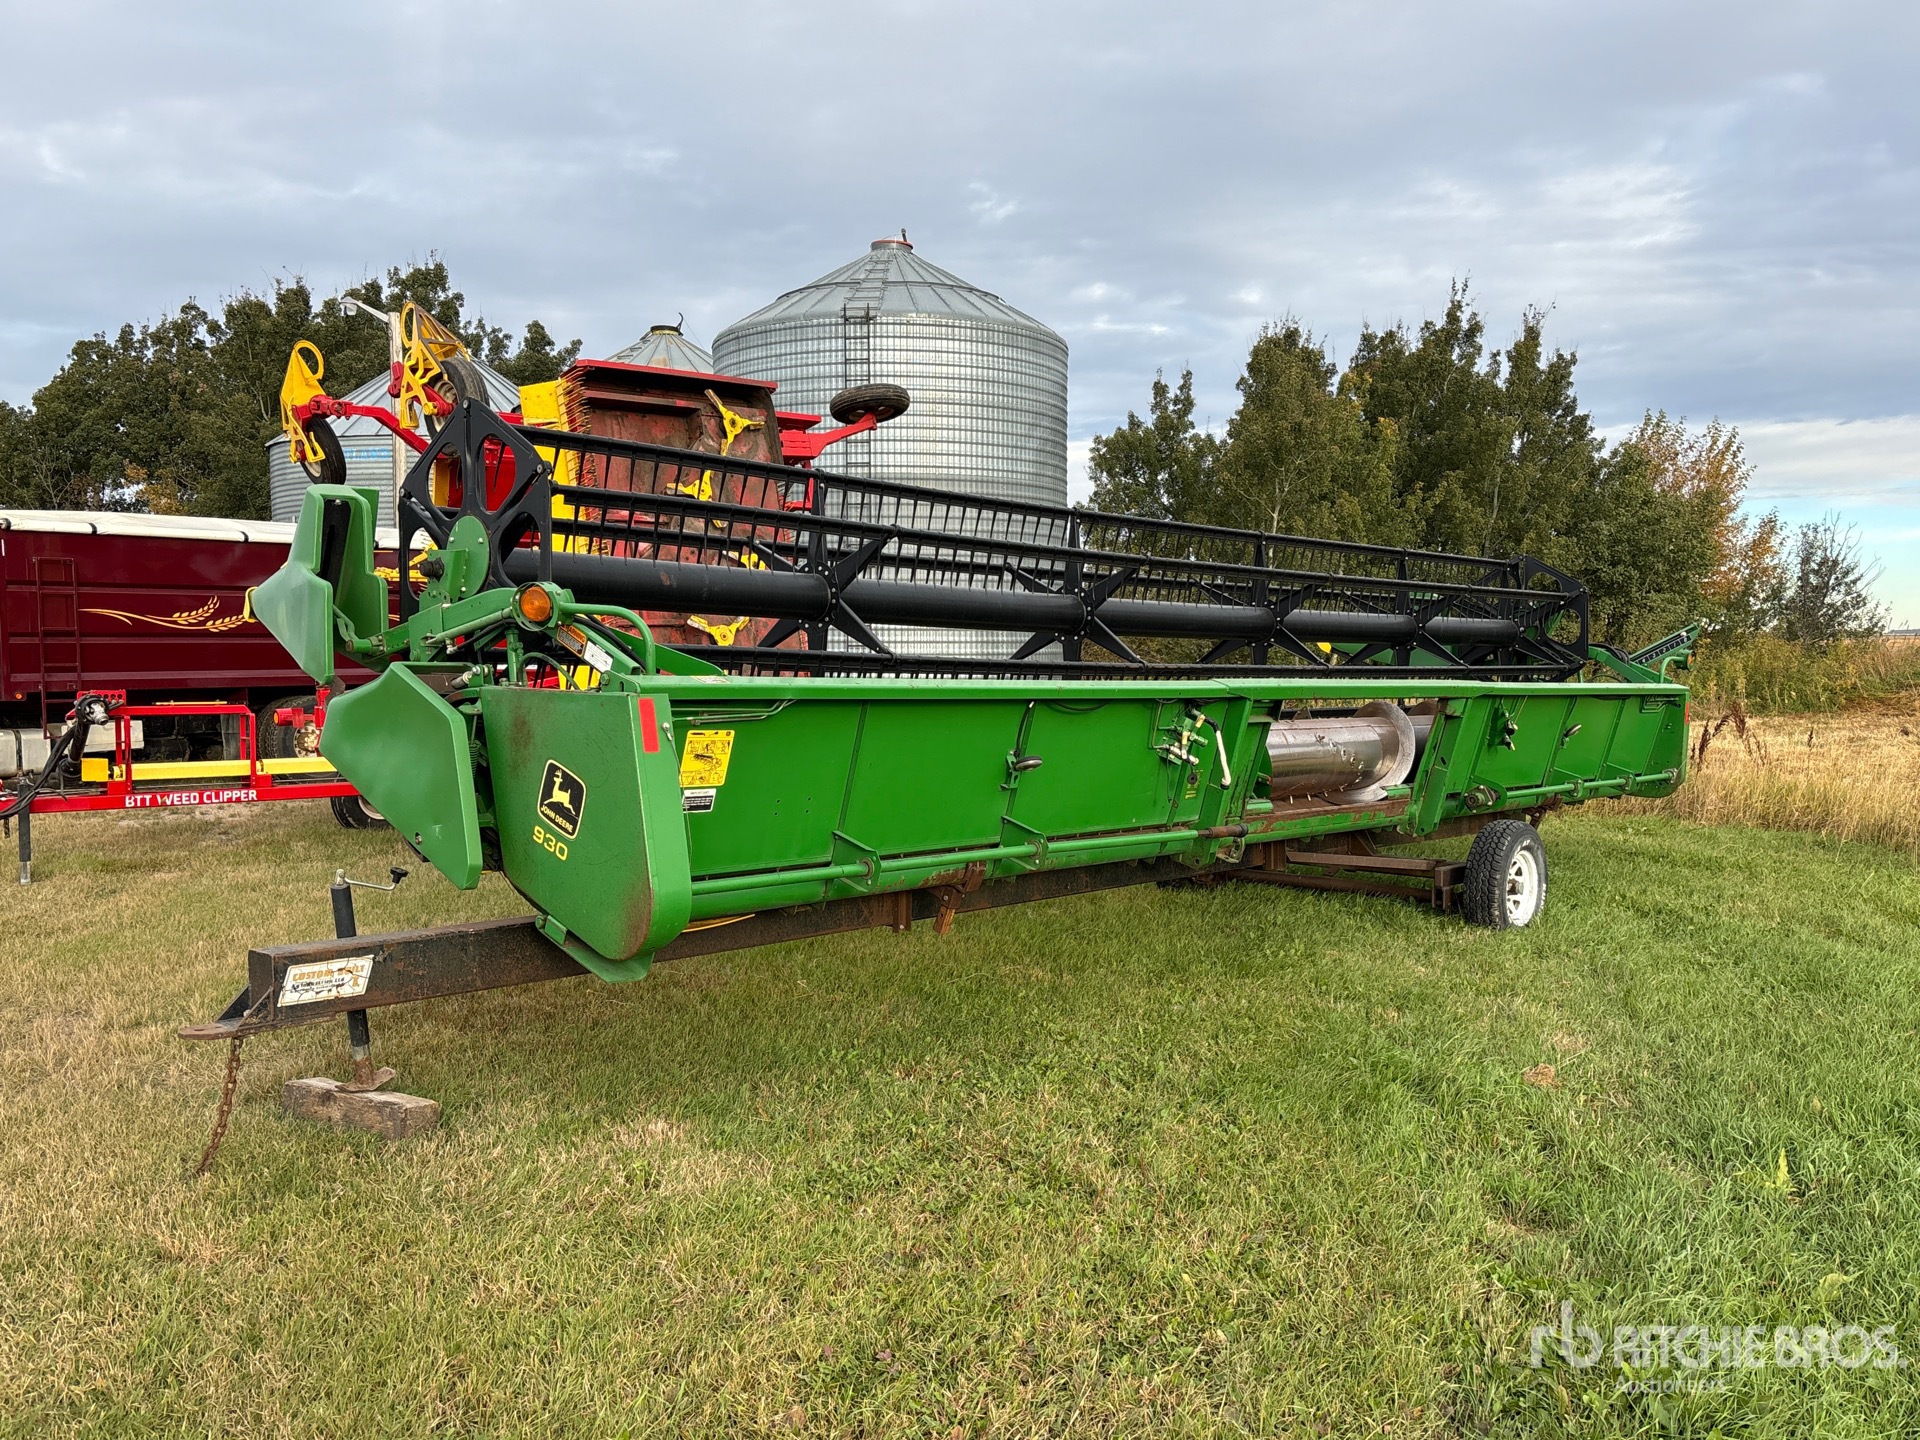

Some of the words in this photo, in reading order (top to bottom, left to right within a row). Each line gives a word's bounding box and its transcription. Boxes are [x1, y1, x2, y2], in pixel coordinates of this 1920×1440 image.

[125, 795, 152, 808] BTT
[157, 792, 200, 806] WEED
[203, 789, 258, 804] CLIPPER
[541, 804, 556, 821] JOHN
[556, 814, 575, 833] DEERE
[532, 825, 569, 861] 930
[292, 968, 335, 982] CUSTOM
